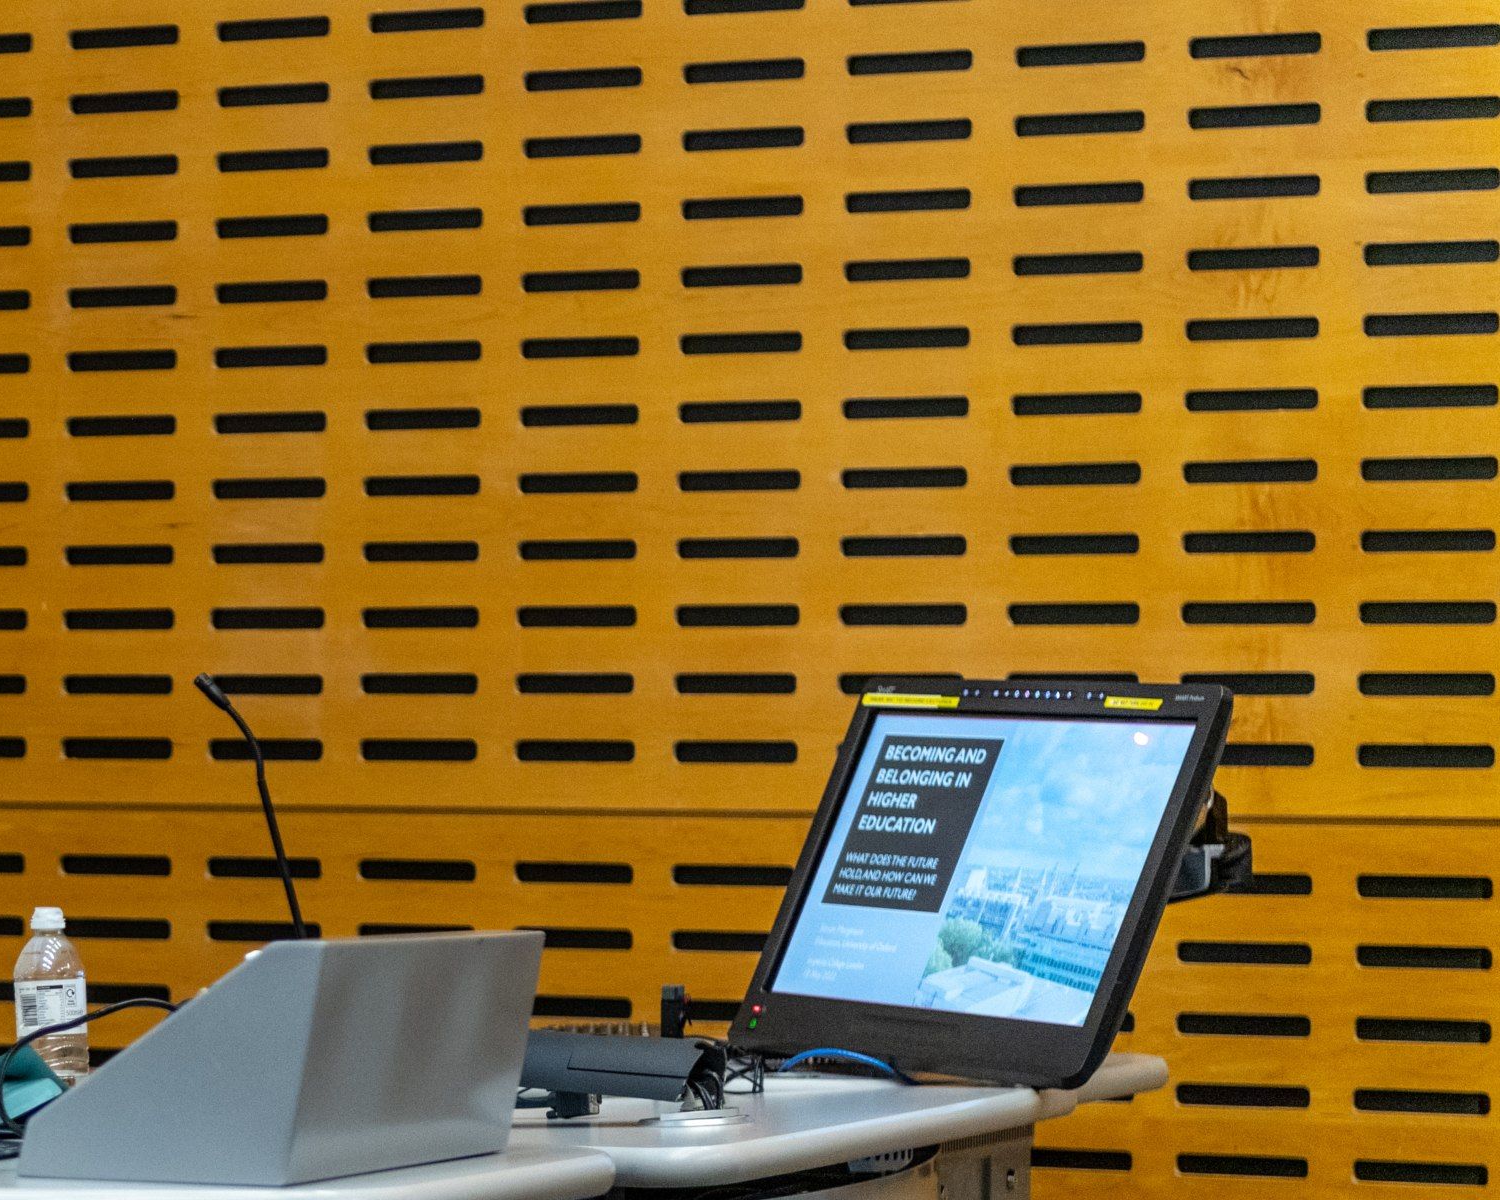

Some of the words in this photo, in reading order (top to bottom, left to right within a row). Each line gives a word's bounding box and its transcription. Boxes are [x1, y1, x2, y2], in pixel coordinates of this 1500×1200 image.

[885, 745, 956, 762] BECOMING
[955, 748, 987, 764] AND
[875, 768, 953, 787] BELONGING
[955, 772, 972, 788] IN
[866, 791, 918, 809] HIGHER
[857, 814, 936, 834] EDUCATION
[845, 852, 870, 864] WHAT
[869, 853, 892, 866] DOES
[891, 855, 908, 867] THE
[907, 856, 939, 870] FUTURE
[861, 869, 882, 881] AND
[881, 870, 905, 883] HOW
[904, 872, 923, 885] CAN
[923, 873, 938, 886] WE
[832, 882, 855, 895] MAKE
[855, 884, 865, 897] IT
[864, 885, 883, 898] OUR
